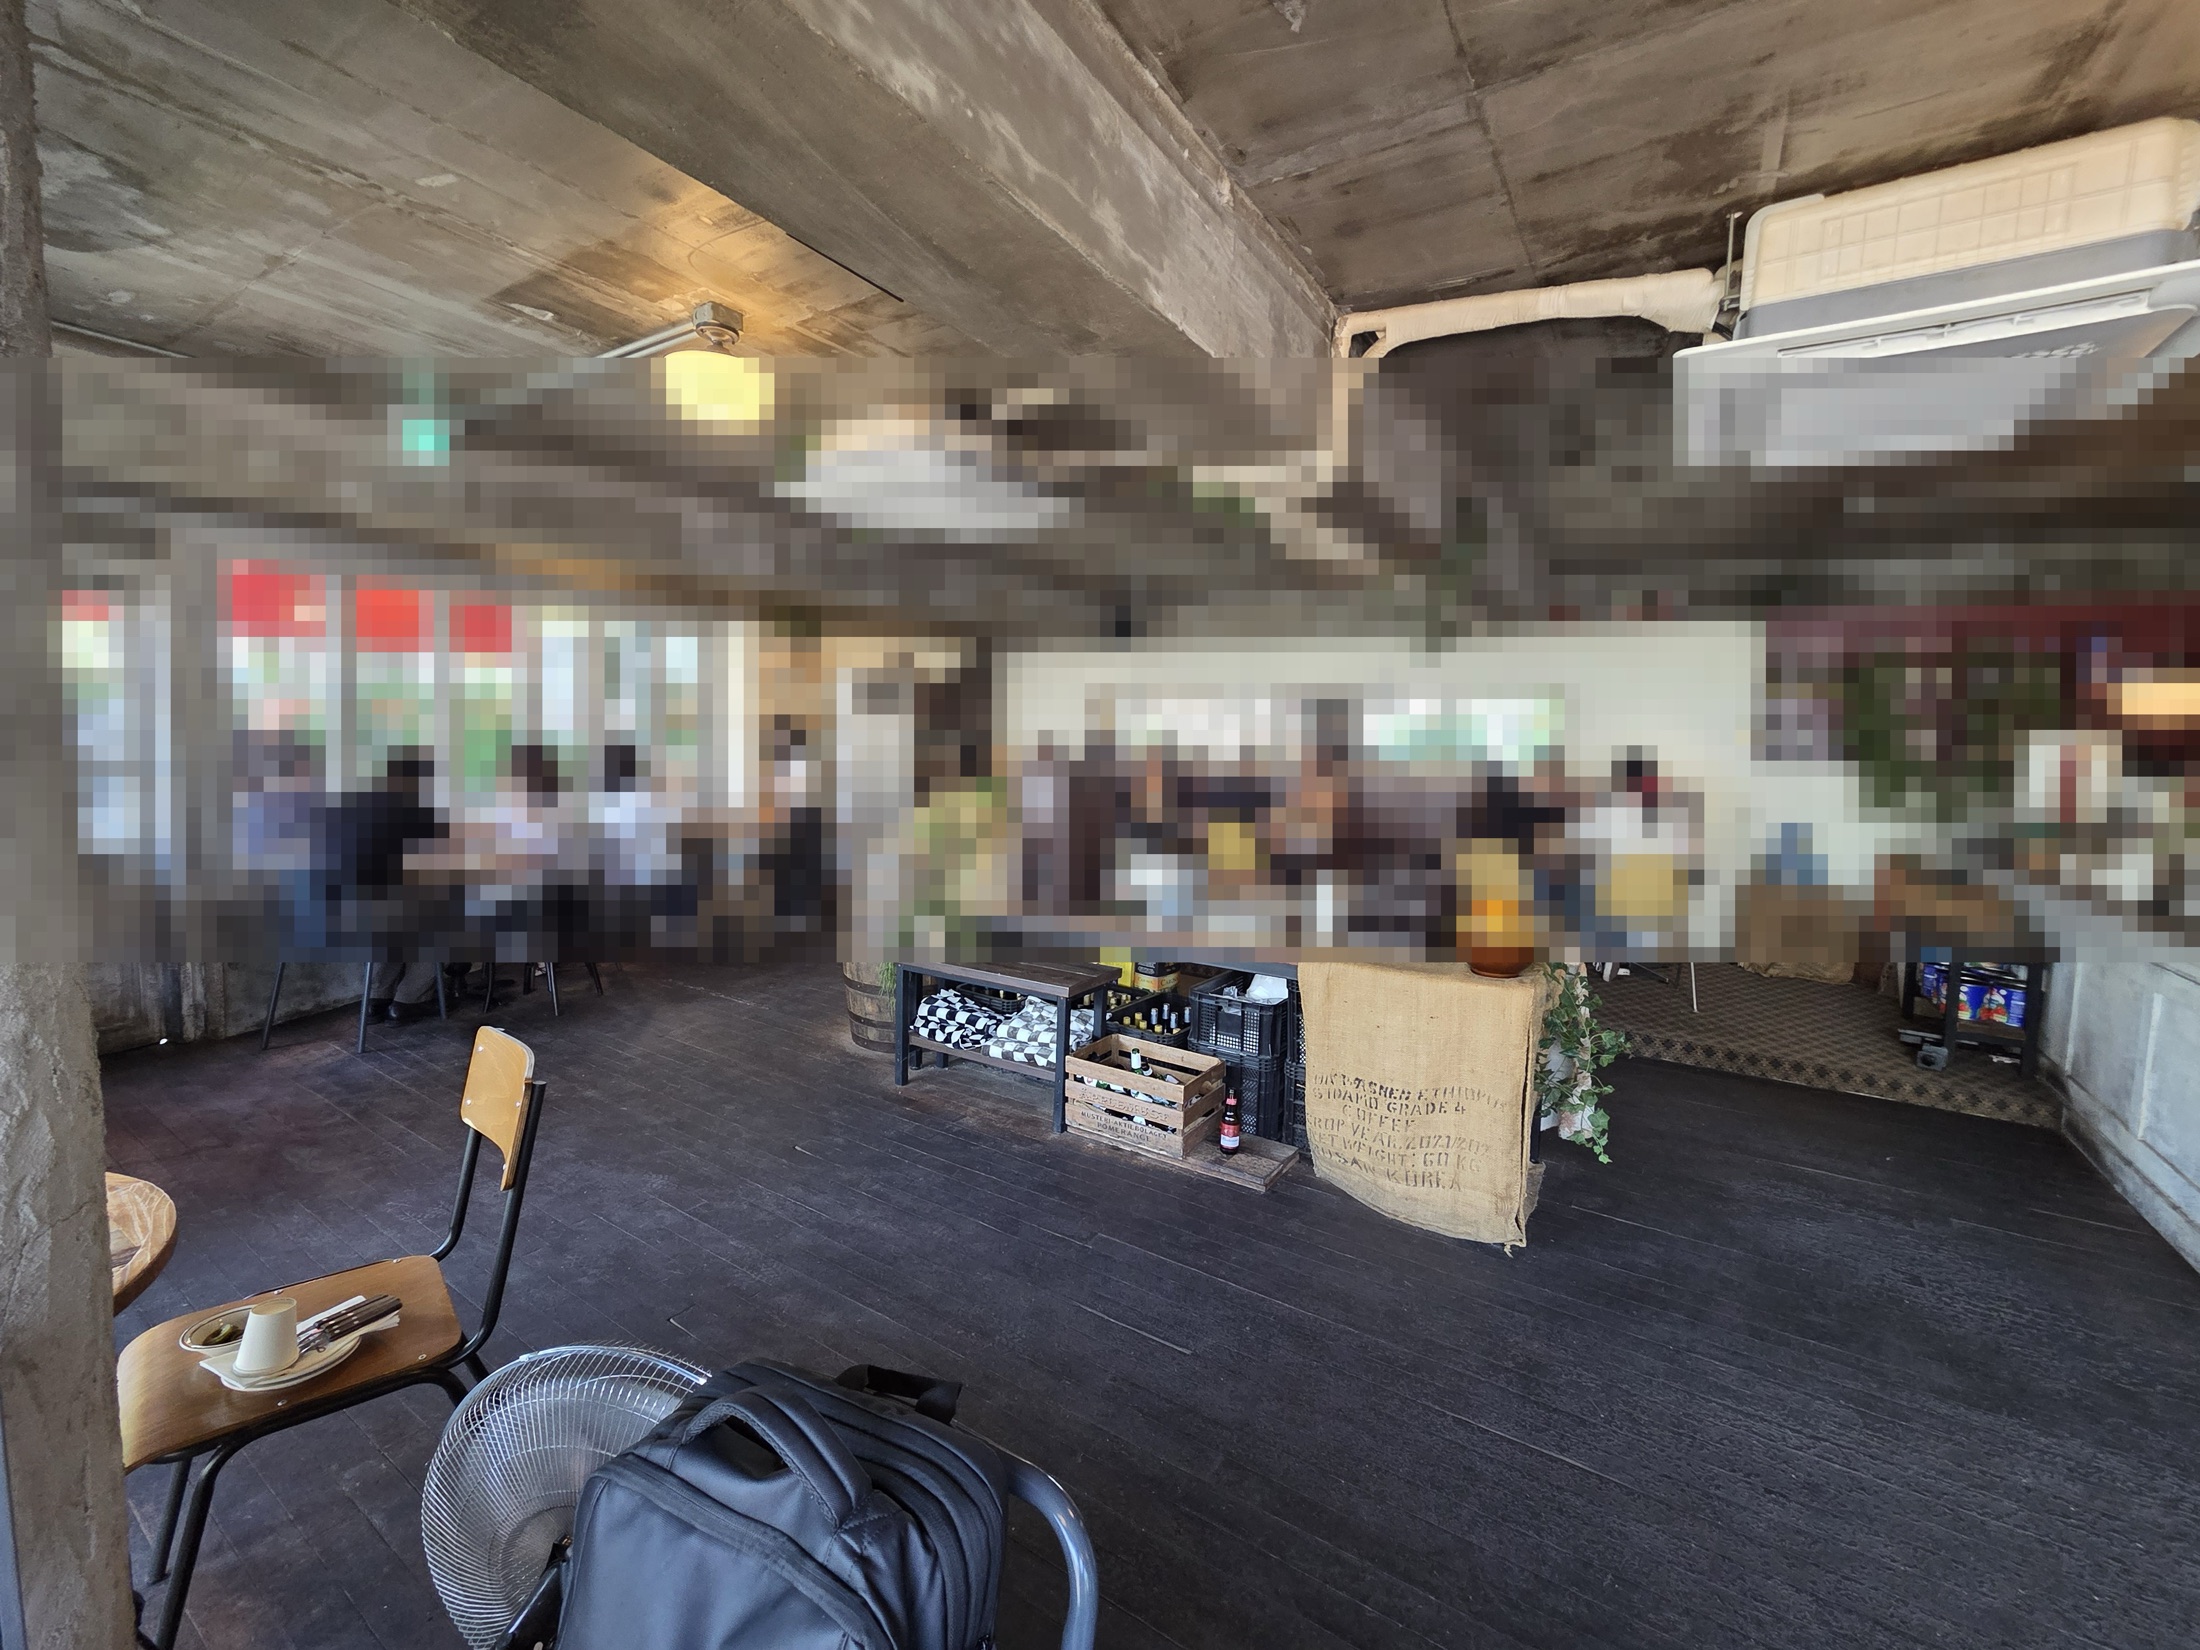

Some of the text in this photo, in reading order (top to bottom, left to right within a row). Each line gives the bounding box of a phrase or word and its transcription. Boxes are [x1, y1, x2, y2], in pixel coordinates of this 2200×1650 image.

[1342, 1104, 1415, 1133] COFFEE
[1387, 1101, 1448, 1117] GRADE
[1454, 1101, 1466, 1115] 4
[1423, 1152, 1449, 1168] 60
[1456, 1154, 1482, 1172] KG
[1386, 1168, 1461, 1192] KOREA
